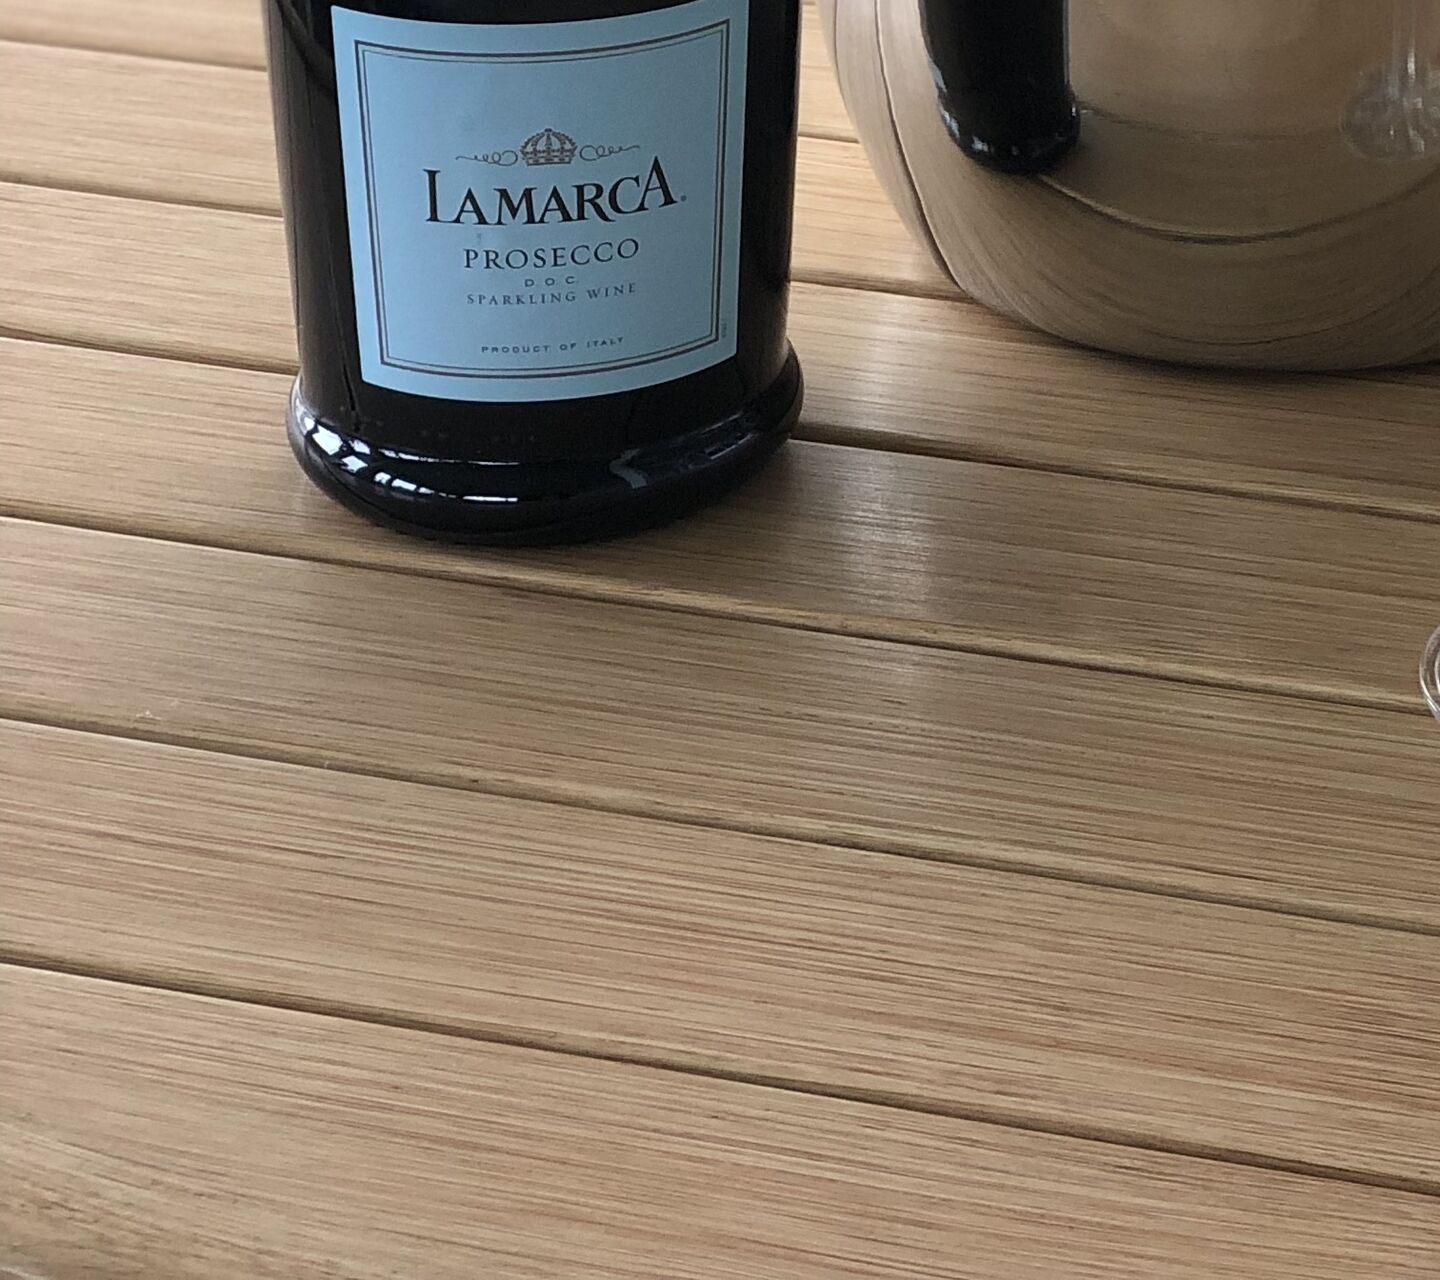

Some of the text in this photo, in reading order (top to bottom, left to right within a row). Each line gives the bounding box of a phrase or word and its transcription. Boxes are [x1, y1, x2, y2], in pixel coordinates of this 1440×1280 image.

[463, 238, 639, 269] PROSECCO
[467, 282, 637, 306] SPARKLING WINE
[481, 336, 624, 354] PRODUCT OF ITALY
